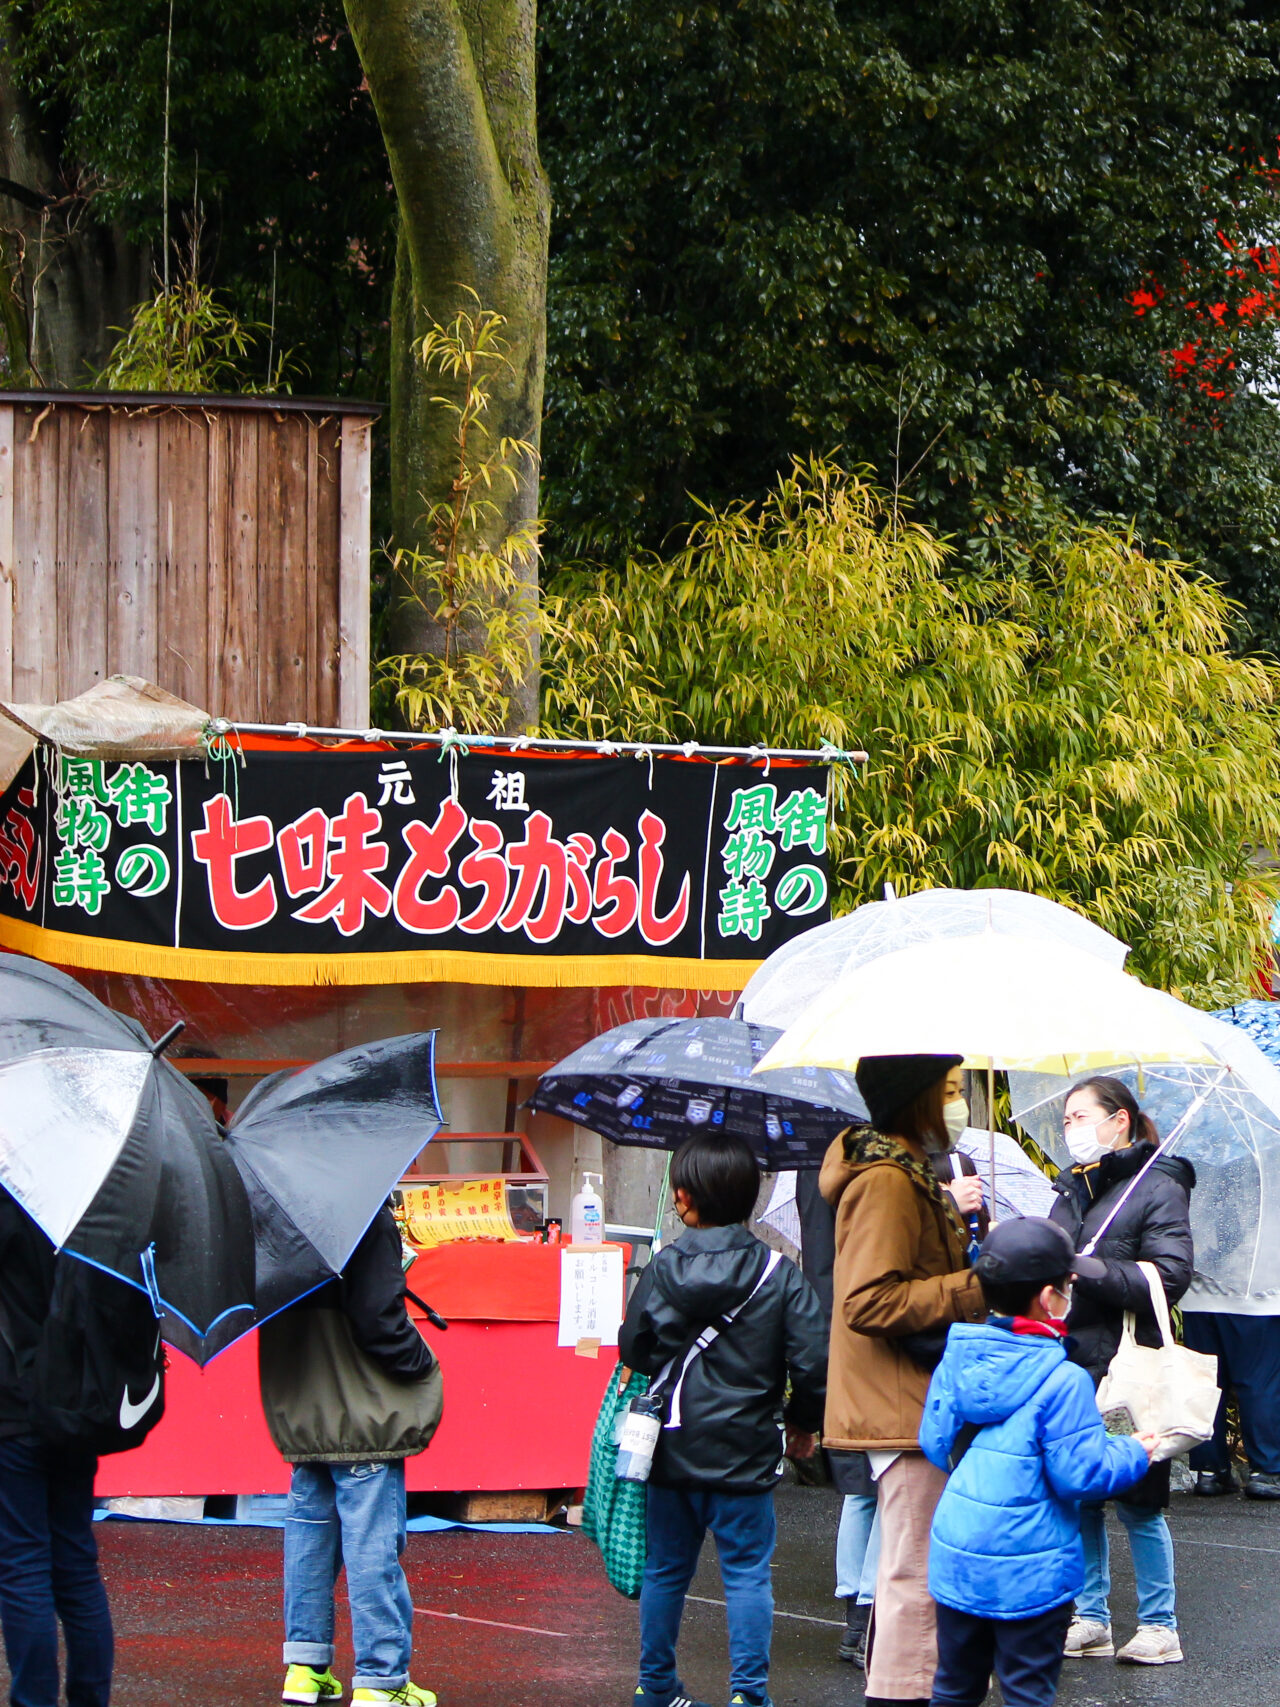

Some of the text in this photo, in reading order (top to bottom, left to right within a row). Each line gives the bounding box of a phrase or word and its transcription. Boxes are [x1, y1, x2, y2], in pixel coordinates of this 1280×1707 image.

[53, 756, 112, 916] 風物詩
[106, 762, 172, 897] 街の
[190, 791, 691, 947] 七味とうがらし
[718, 783, 778, 941] 風物詩
[774, 786, 828, 917] 街の
